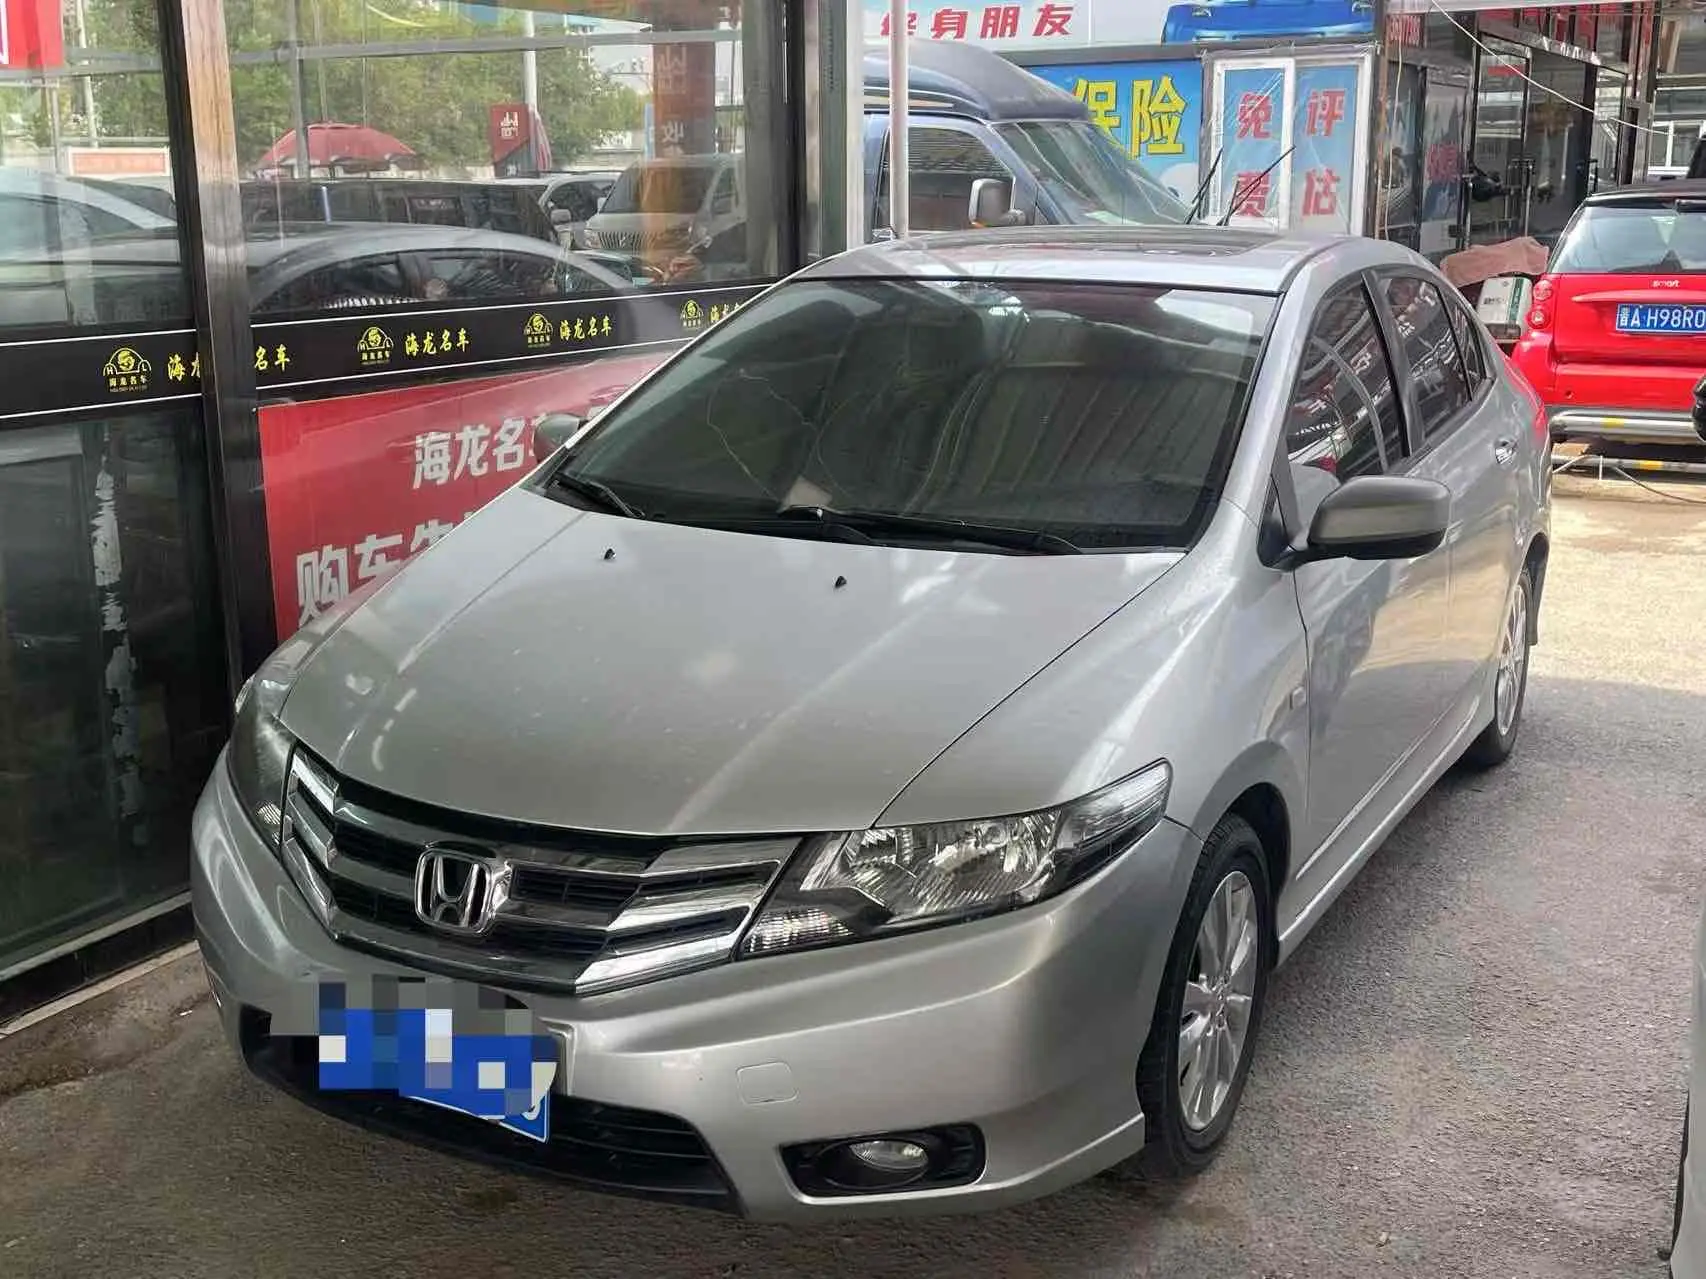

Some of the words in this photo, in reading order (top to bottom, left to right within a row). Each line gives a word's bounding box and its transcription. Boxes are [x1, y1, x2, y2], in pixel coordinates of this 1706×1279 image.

[1073, 75, 1187, 159] 保险
[1303, 88, 1346, 216] 评估
[405, 327, 469, 357] 海龙名车
[560, 314, 612, 342] 海龙名车
[254, 343, 290, 372] 名车
[412, 413, 536, 489] 海龙名
